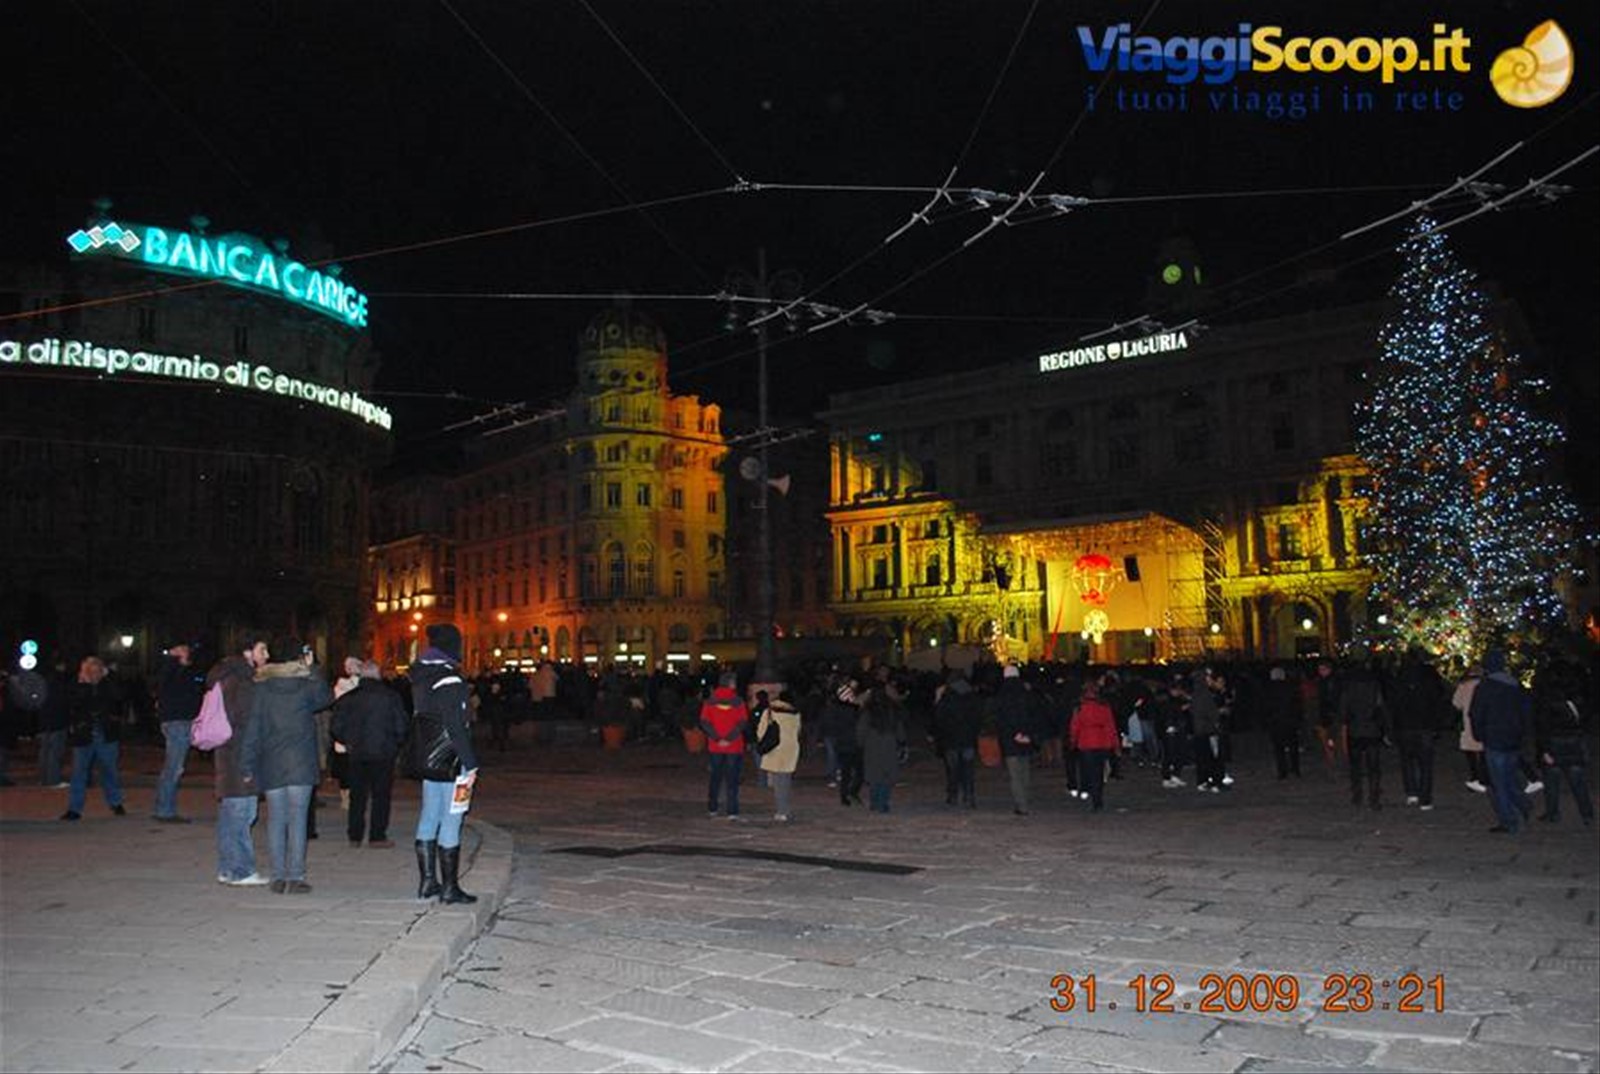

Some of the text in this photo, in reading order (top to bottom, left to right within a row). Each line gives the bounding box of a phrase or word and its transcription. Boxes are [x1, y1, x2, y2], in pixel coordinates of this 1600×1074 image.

[143, 226, 368, 327] BANCA CARIGE
[28, 338, 60, 365] di
[63, 340, 220, 381] Risparmio
[224, 361, 250, 387] di
[253, 365, 340, 408] Genova
[340, 391, 351, 411] e
[1039, 332, 1188, 372] REGIONE LIGURIA
